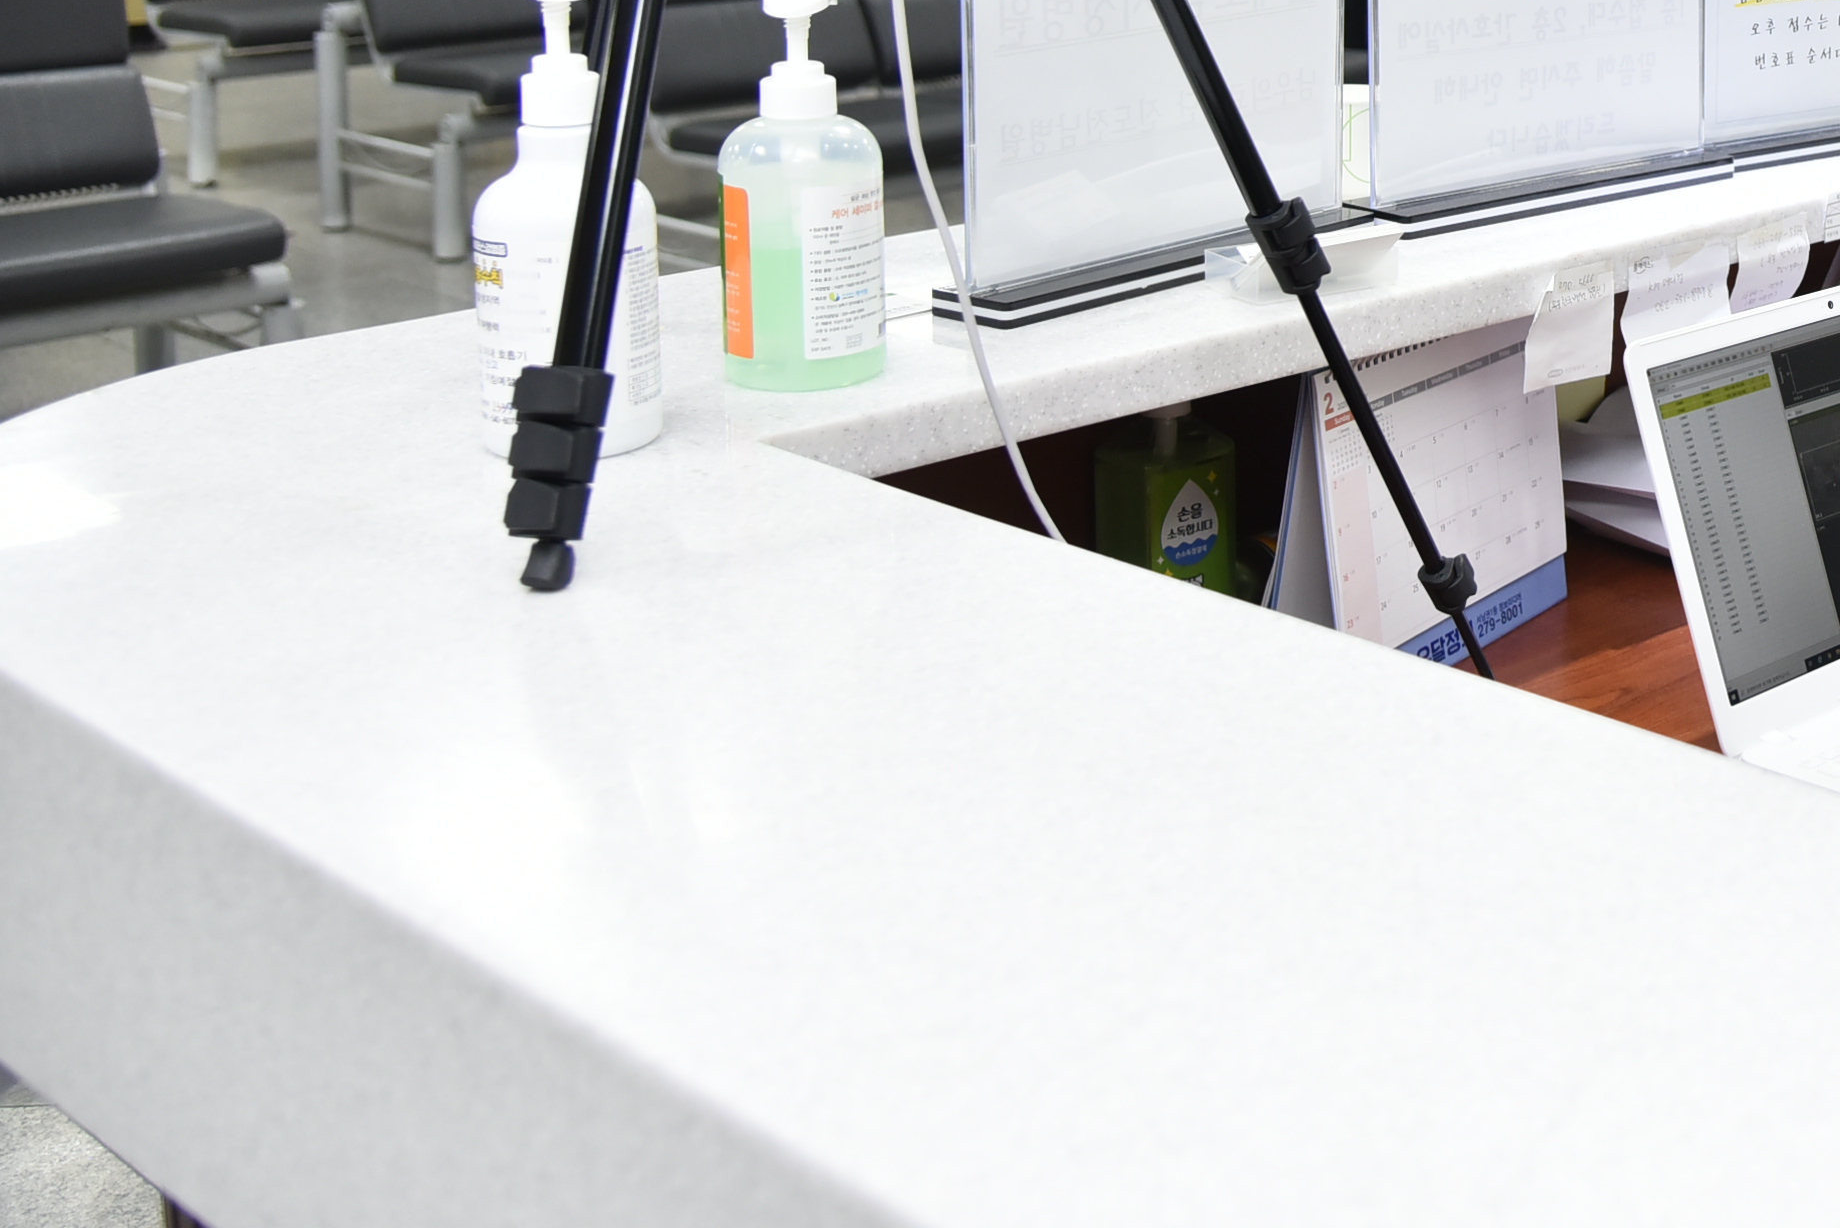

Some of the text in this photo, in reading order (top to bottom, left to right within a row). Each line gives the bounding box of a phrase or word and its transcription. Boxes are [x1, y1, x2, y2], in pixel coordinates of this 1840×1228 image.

[1750, 17, 1776, 36] 오후
[1787, 13, 1829, 33] 접수는
[1754, 51, 1795, 70] 번호표
[831, 207, 849, 219] 케어
[1334, 414, 1352, 425] Sunday
[1371, 400, 1385, 409] onday
[1401, 386, 1419, 396] Tuesday
[1431, 372, 1454, 385] Wednesday
[1465, 360, 1483, 371] Thursday
[1323, 392, 1334, 416] 2
[1177, 502, 1204, 522] 손을
[1167, 518, 1213, 540] 소독합시다
[1477, 602, 1524, 638] 279-8001
